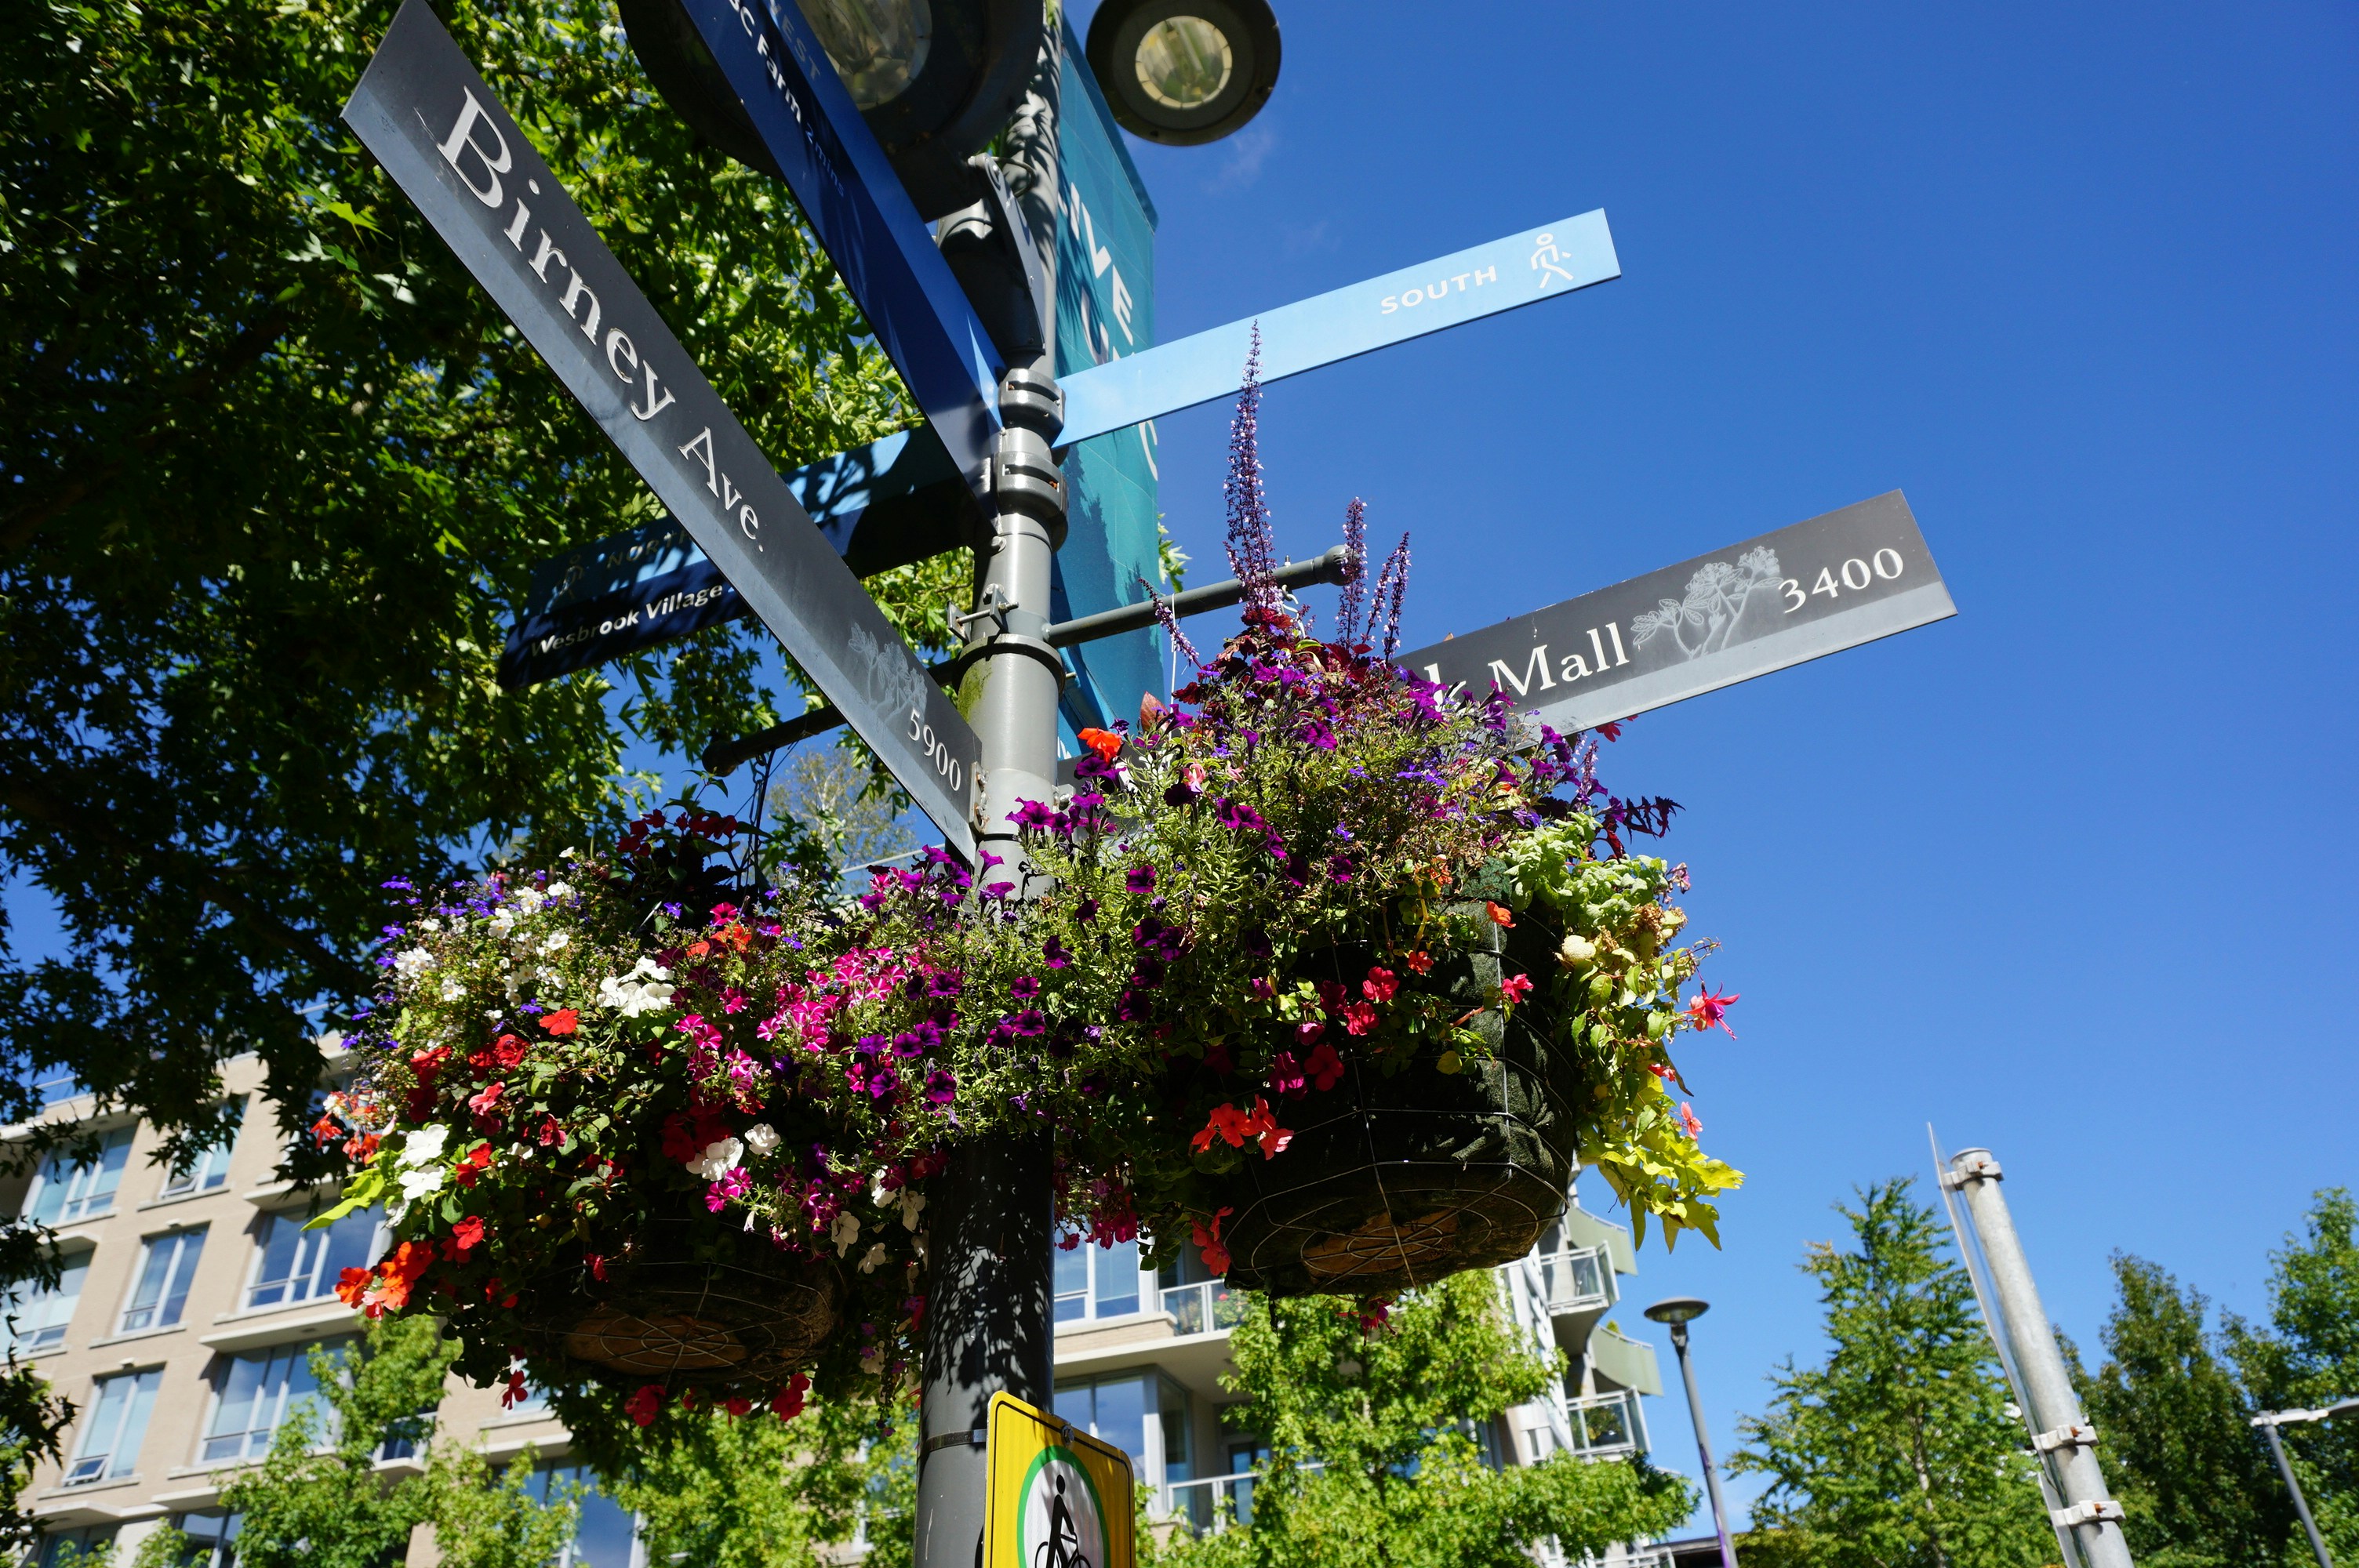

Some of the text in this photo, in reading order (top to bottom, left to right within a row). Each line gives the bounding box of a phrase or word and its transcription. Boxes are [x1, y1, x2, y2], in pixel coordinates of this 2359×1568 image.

[756, 33, 801, 124] Farm
[805, 122, 814, 145] 2
[815, 143, 845, 198] mins
[1057, 182, 1133, 346] IVE
[1380, 265, 1497, 314] SOUTH
[436, 85, 764, 552] Birney Ave.
[531, 584, 722, 657] Wesbrook Village
[1778, 547, 1905, 615] 3400
[1488, 622, 1630, 697] Mall
[907, 709, 961, 792] 5900
